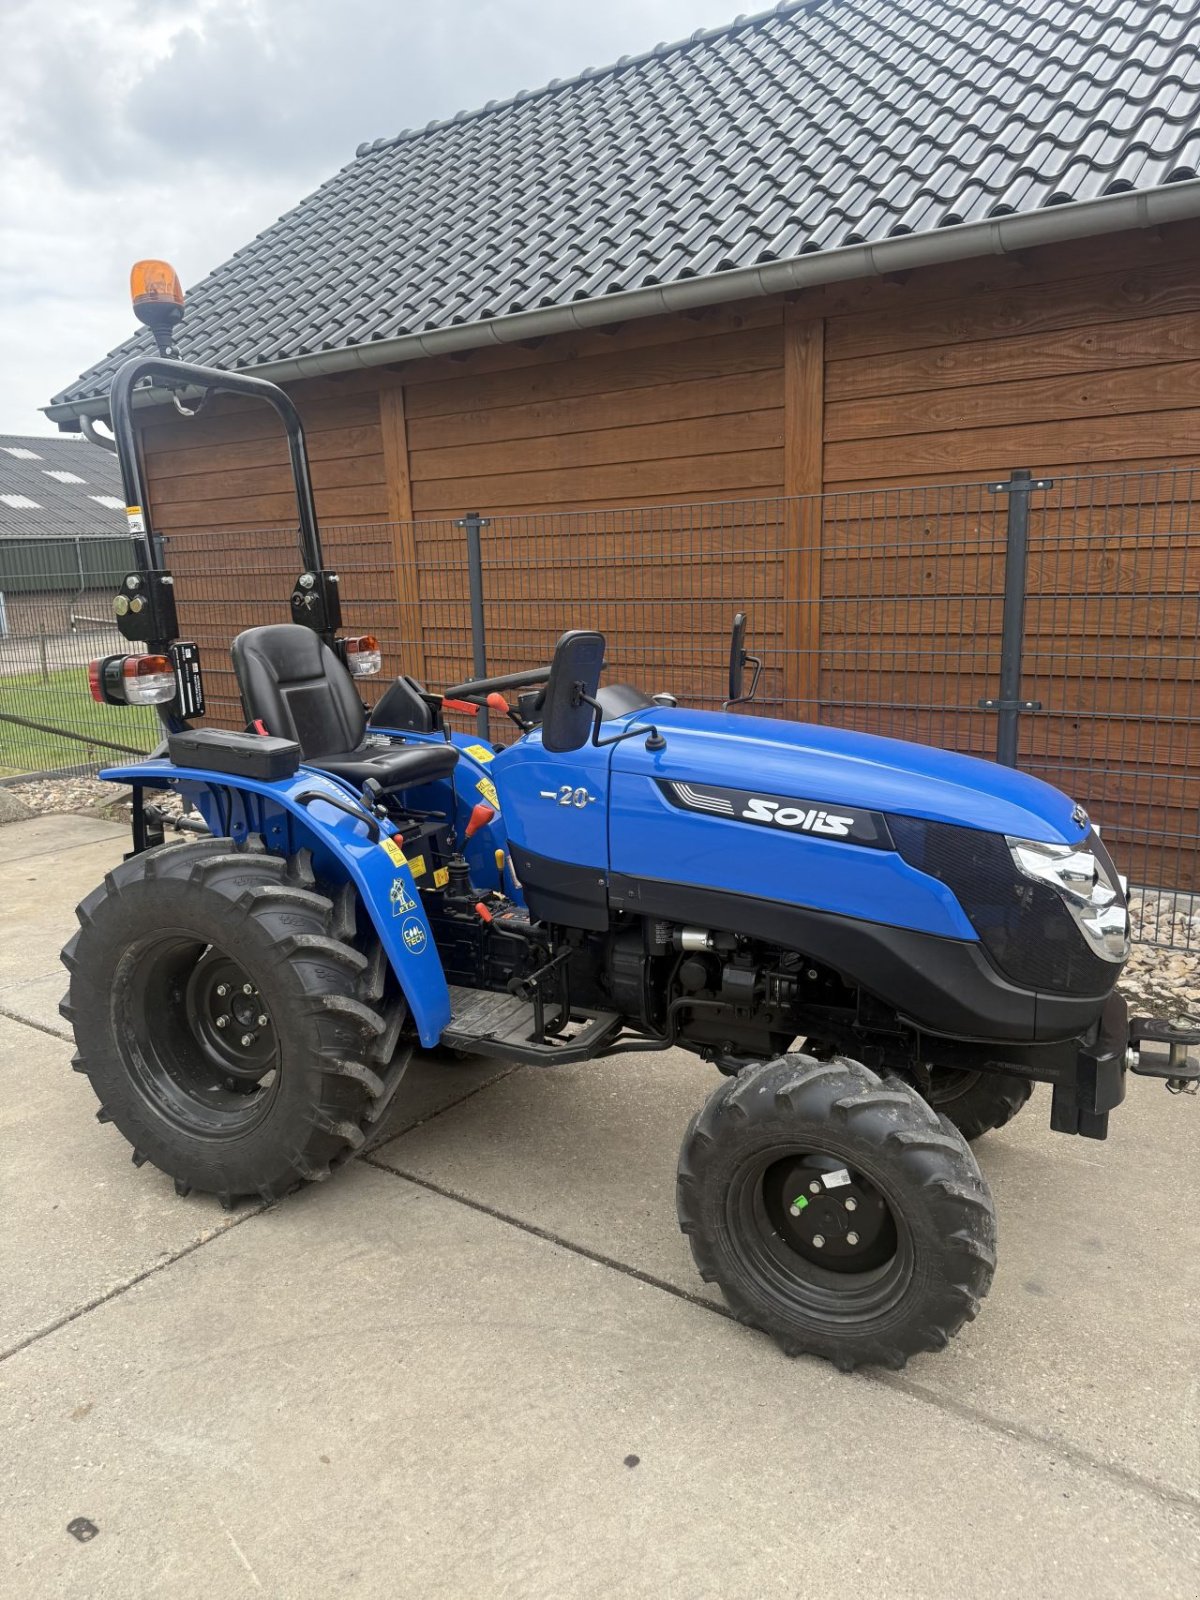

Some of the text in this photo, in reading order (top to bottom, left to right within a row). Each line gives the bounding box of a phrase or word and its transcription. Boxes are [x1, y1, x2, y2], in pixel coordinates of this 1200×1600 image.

[559, 785, 588, 808] 20
[399, 901, 416, 913] PTO
[406, 934, 425, 947] TECH
